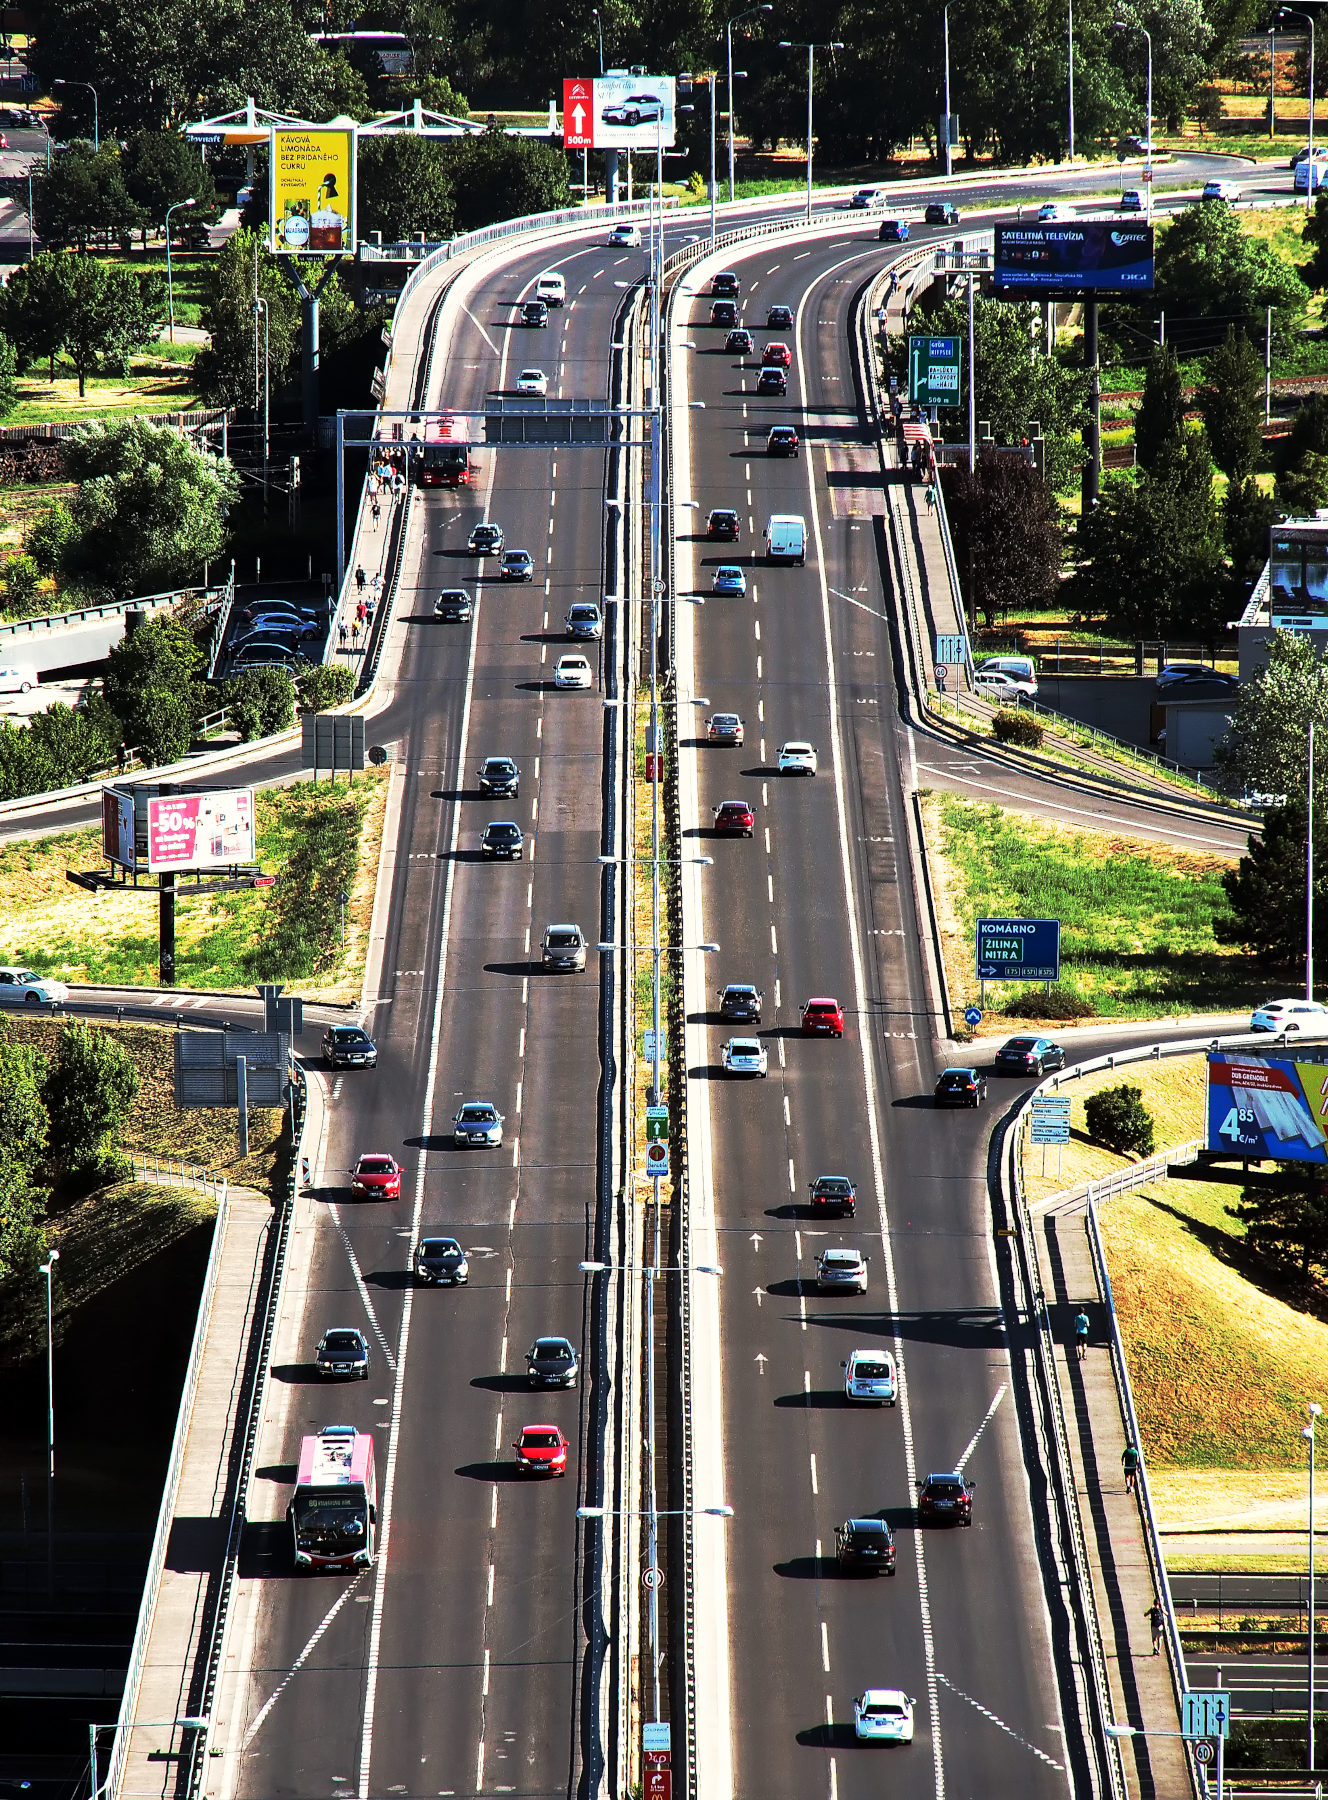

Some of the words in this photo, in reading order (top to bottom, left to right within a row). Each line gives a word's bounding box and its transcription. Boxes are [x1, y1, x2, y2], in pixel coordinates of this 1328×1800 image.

[280, 134, 310, 143] KÁVOVÁ
[280, 144, 320, 152] LIMONÁDA
[296, 152, 338, 161] PRIDANÉHO
[1001, 230, 1044, 240] SATELITNÁ
[1045, 230, 1084, 240] TELEVÍZIA
[982, 923, 1036, 934] KOMÁRNO
[986, 939, 1018, 948] ŽILINA
[986, 951, 1018, 960] NITRA
[1242, 1074, 1268, 1082] GRENOBLE
[1219, 1108, 1240, 1142] 4
[1239, 1108, 1254, 1122] 85
[1198, 1748, 1208, 1759] 60
